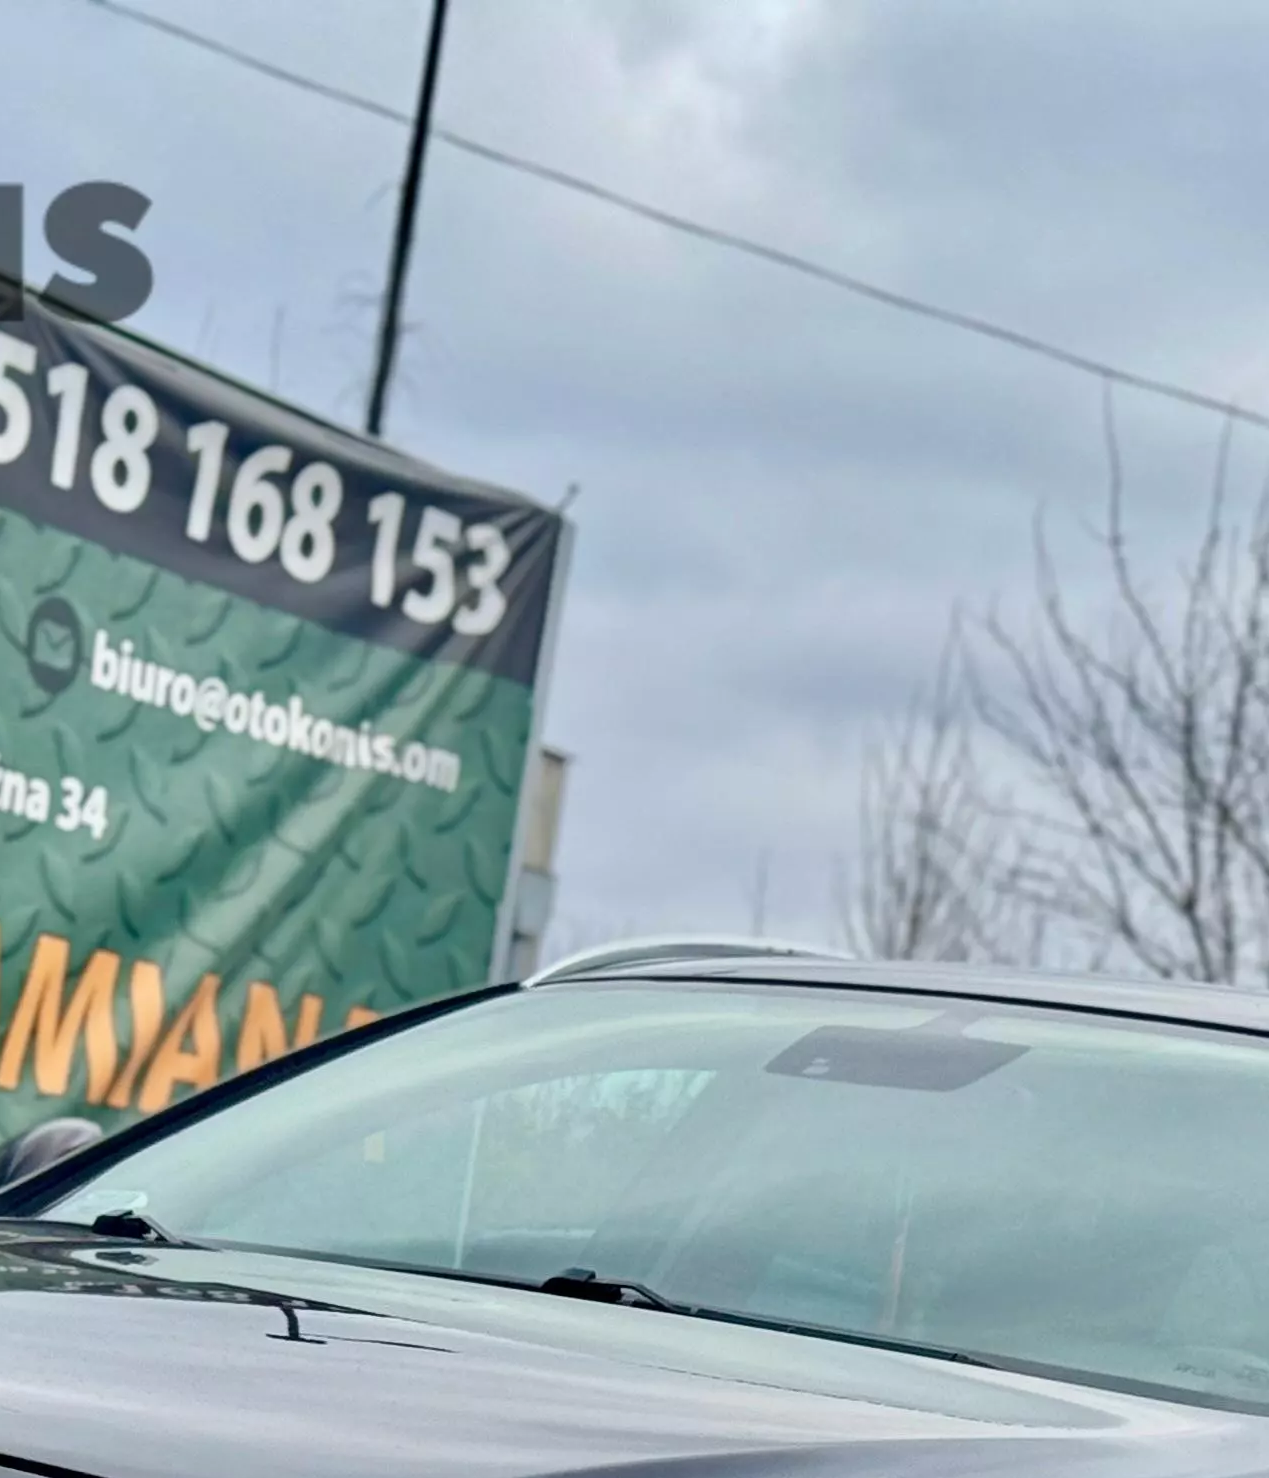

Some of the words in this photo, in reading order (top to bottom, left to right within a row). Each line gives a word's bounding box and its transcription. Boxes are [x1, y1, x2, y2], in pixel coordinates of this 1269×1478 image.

[185, 420, 343, 583] 168
[367, 491, 511, 636] 153
[54, 776, 109, 840] 34
